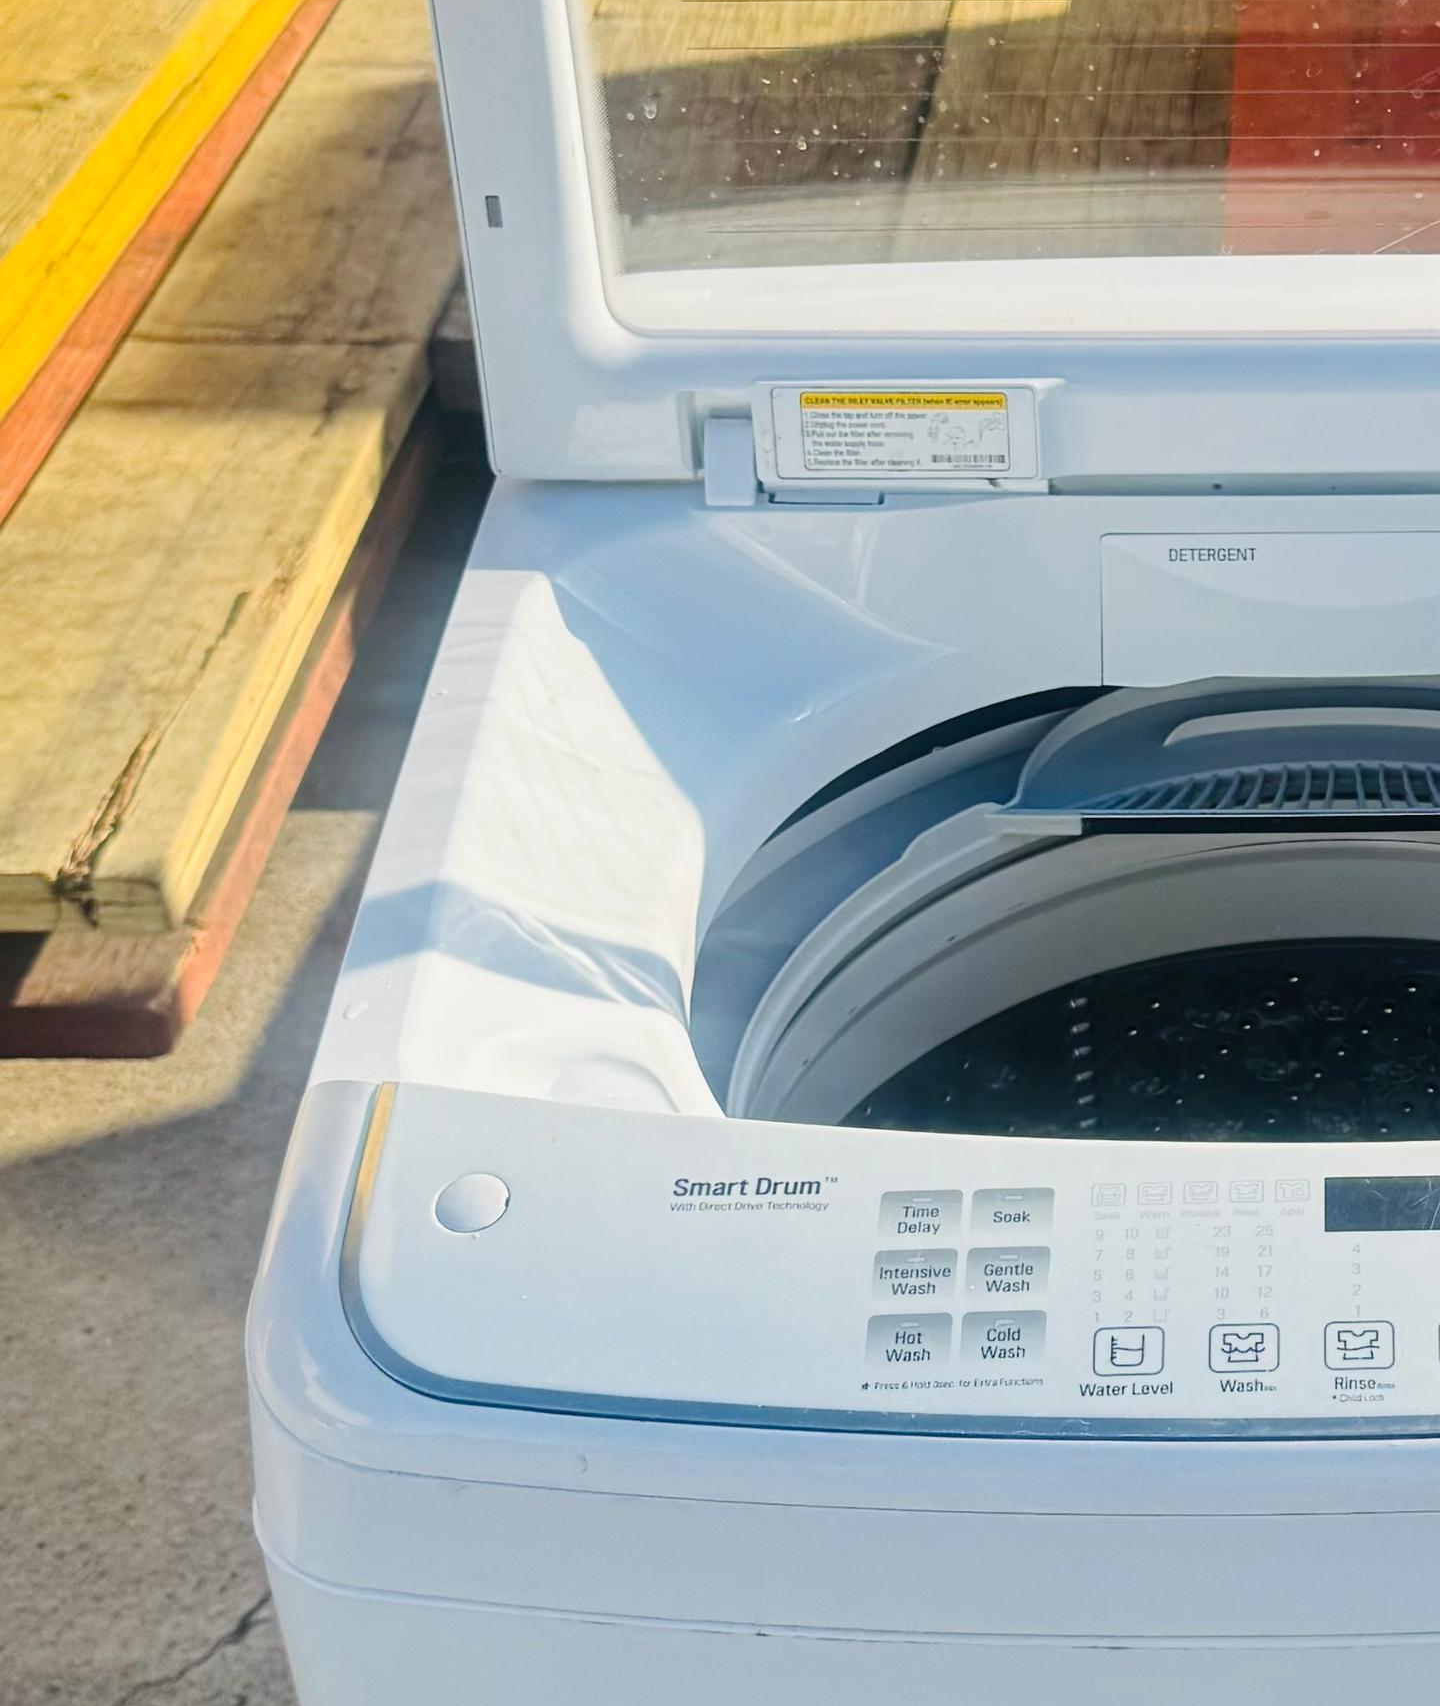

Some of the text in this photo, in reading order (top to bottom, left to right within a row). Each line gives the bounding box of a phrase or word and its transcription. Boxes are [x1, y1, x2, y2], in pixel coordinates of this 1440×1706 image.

[1168, 547, 1257, 563] DETERGENT
[672, 1178, 750, 1197] Smart
[670, 1200, 829, 1213] With Direct Drive Technology
[901, 1205, 940, 1219] Time
[992, 1210, 1031, 1224] Soak
[897, 1221, 941, 1236] Delay
[1095, 1228, 1104, 1240] 9
[1124, 1227, 1139, 1239] 10
[1213, 1225, 1231, 1238] 23
[1256, 1224, 1274, 1237] 25
[1125, 1248, 1135, 1260] 8
[1216, 1245, 1230, 1258] 19
[1257, 1244, 1273, 1257] 21
[1352, 1242, 1361, 1254] 4
[1095, 1249, 1104, 1261] 7
[879, 1265, 952, 1280] Intensive
[983, 1262, 1034, 1278] Gentle
[1125, 1268, 1135, 1281] 6
[1215, 1266, 1230, 1278] 14
[1258, 1265, 1272, 1277] 17
[1352, 1262, 1361, 1275] 3
[891, 1282, 936, 1296] Wash
[985, 1279, 1031, 1293] Wash
[1214, 1286, 1229, 1299] 10
[1256, 1285, 1273, 1298] 12
[1352, 1283, 1362, 1296] 2
[1092, 1290, 1102, 1303] 3
[1124, 1289, 1134, 1302] 4
[1123, 1310, 1133, 1323] 2
[1216, 1308, 1226, 1321] 3
[1260, 1307, 1269, 1319] 6
[894, 1331, 923, 1345] Hot
[986, 1327, 1021, 1342] Cold
[885, 1348, 931, 1363] Wash
[980, 1345, 1026, 1359] Wash
[1078, 1381, 1174, 1397] Water Level
[1219, 1379, 1264, 1393] Wash
[1334, 1376, 1376, 1390] Rinse
